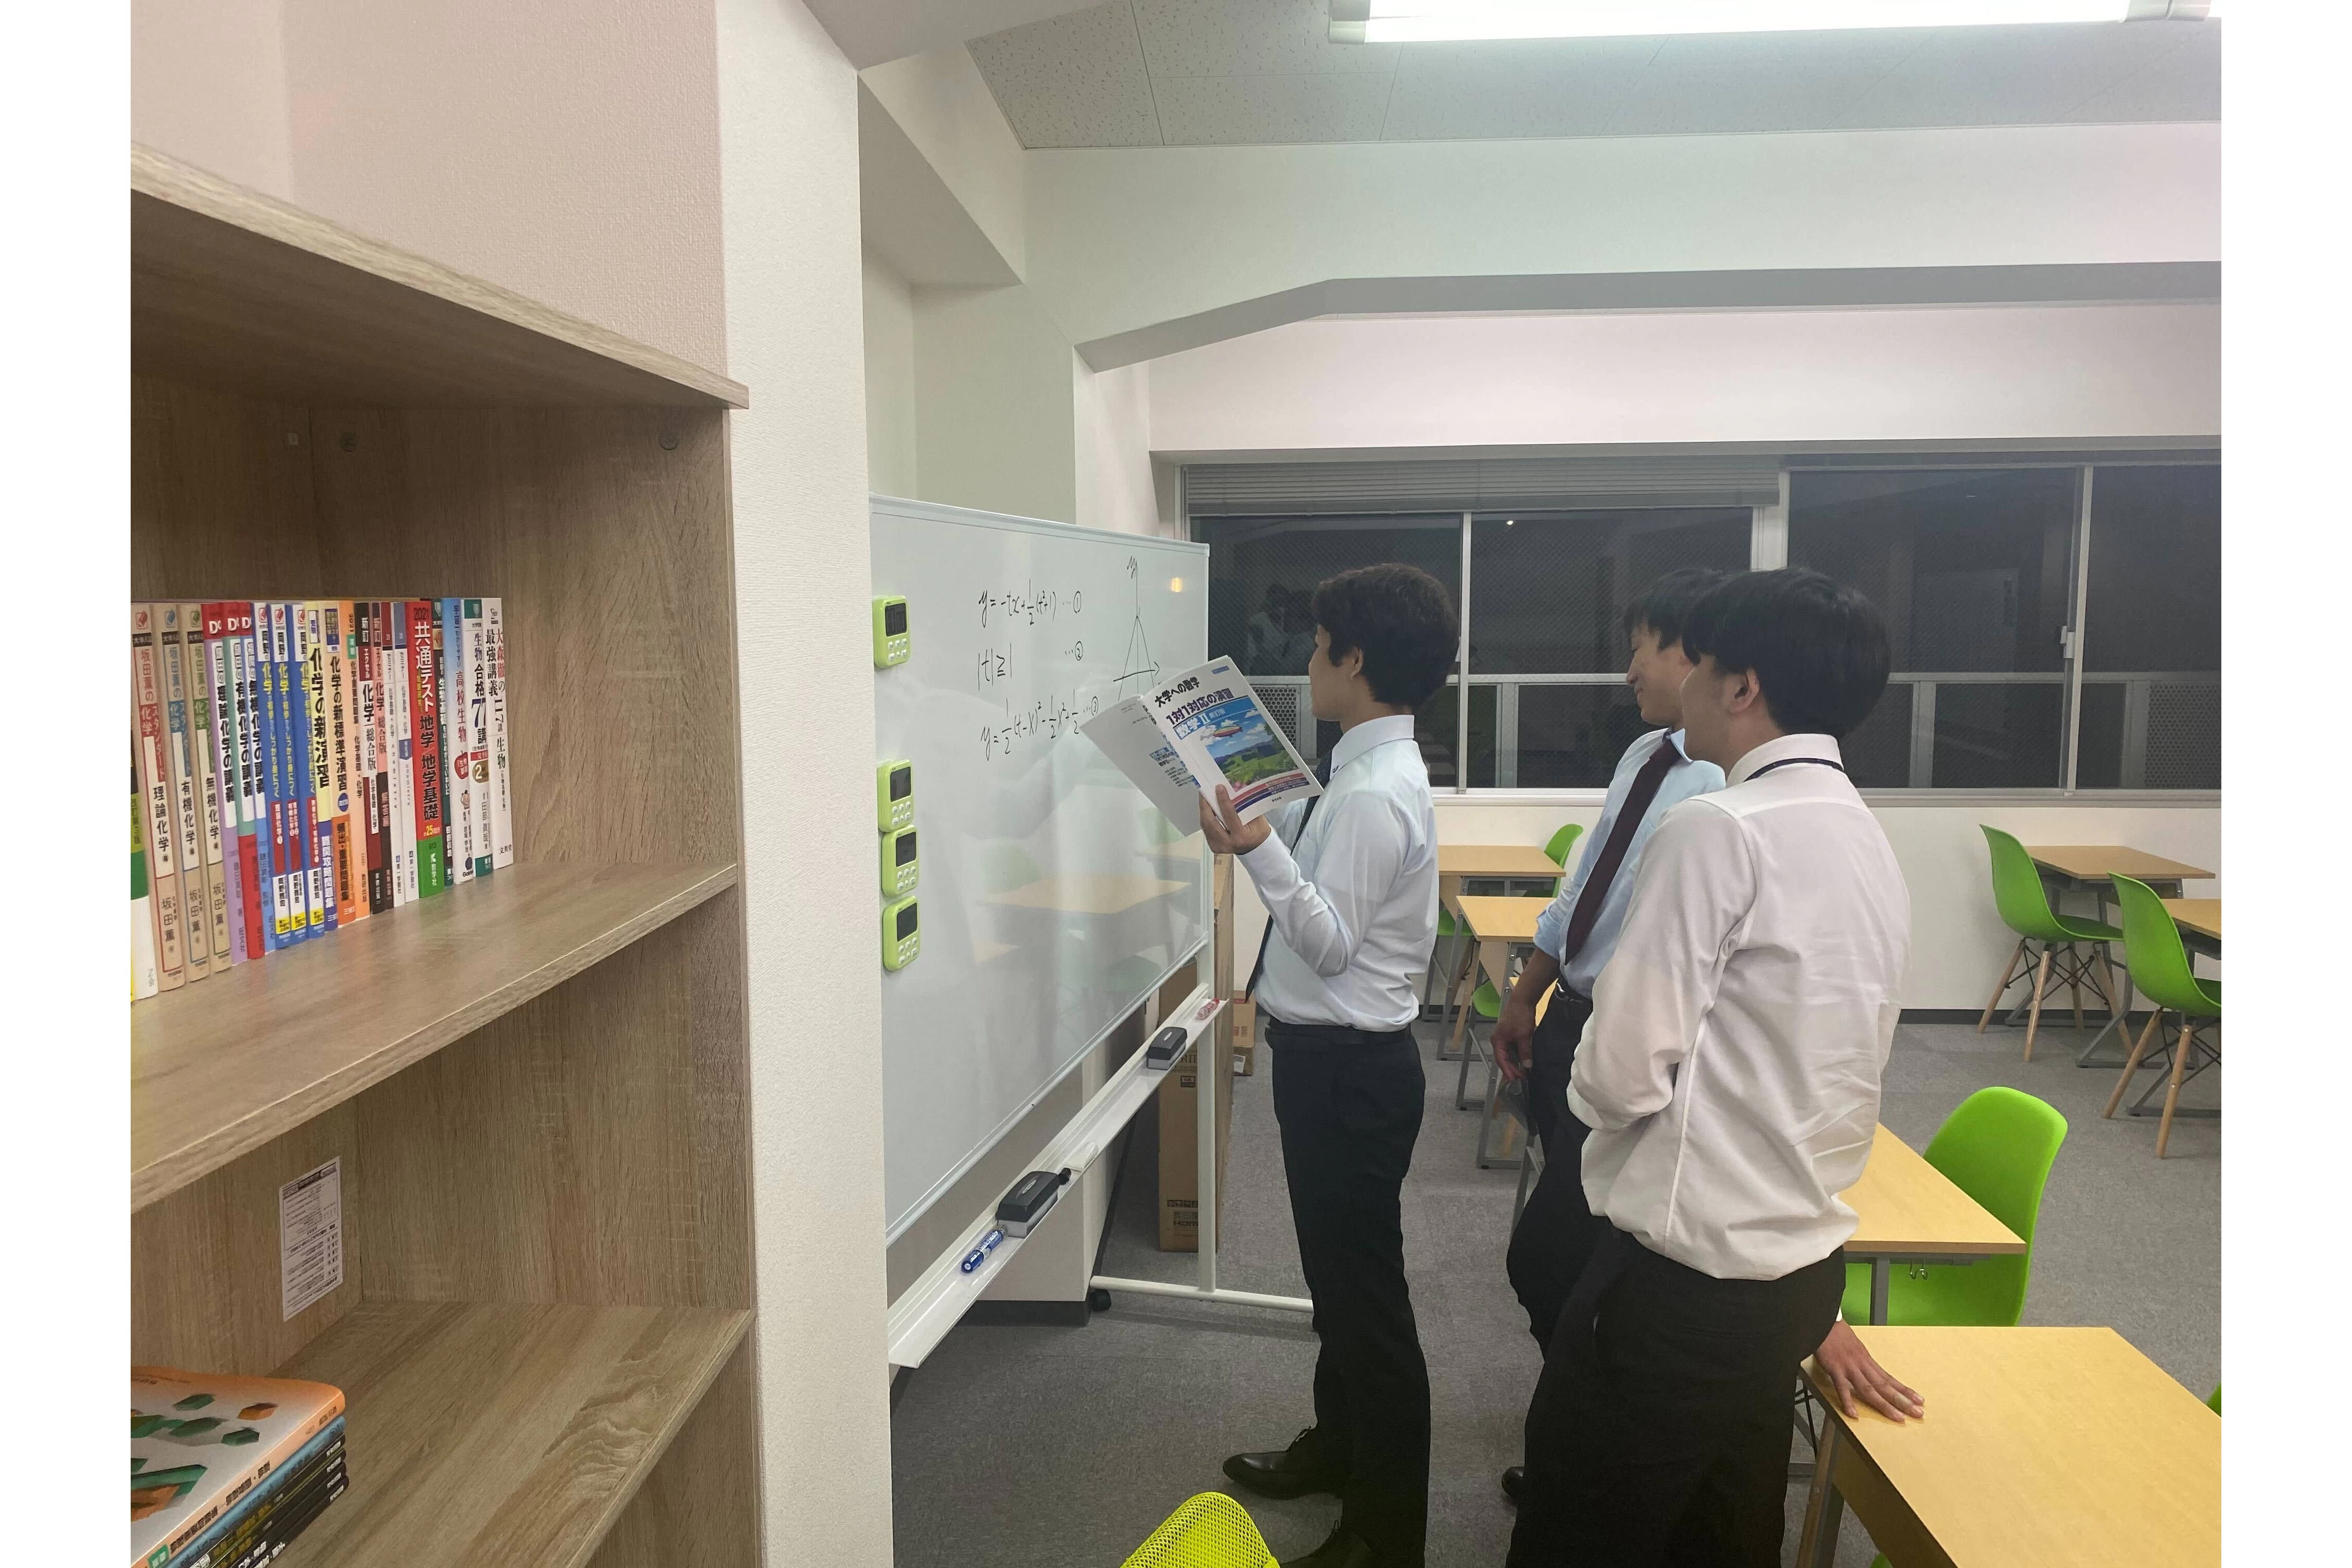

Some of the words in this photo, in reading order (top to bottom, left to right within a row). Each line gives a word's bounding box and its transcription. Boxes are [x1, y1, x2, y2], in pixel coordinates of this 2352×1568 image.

[414, 621, 435, 712] 共通テスト
[486, 629, 498, 697] 最強講義
[363, 684, 375, 722] 化学
[376, 682, 385, 711] 化学
[455, 671, 467, 743] 高校生物
[1155, 677, 1200, 708] 大学への数学
[1166, 688, 1235, 725] 1対1対応の演習
[310, 648, 329, 789] 化学の新演習
[330, 656, 347, 791] 化学の新標準演習
[378, 716, 387, 754] 総合版
[366, 728, 376, 771] 総合版
[497, 737, 506, 769] 生物
